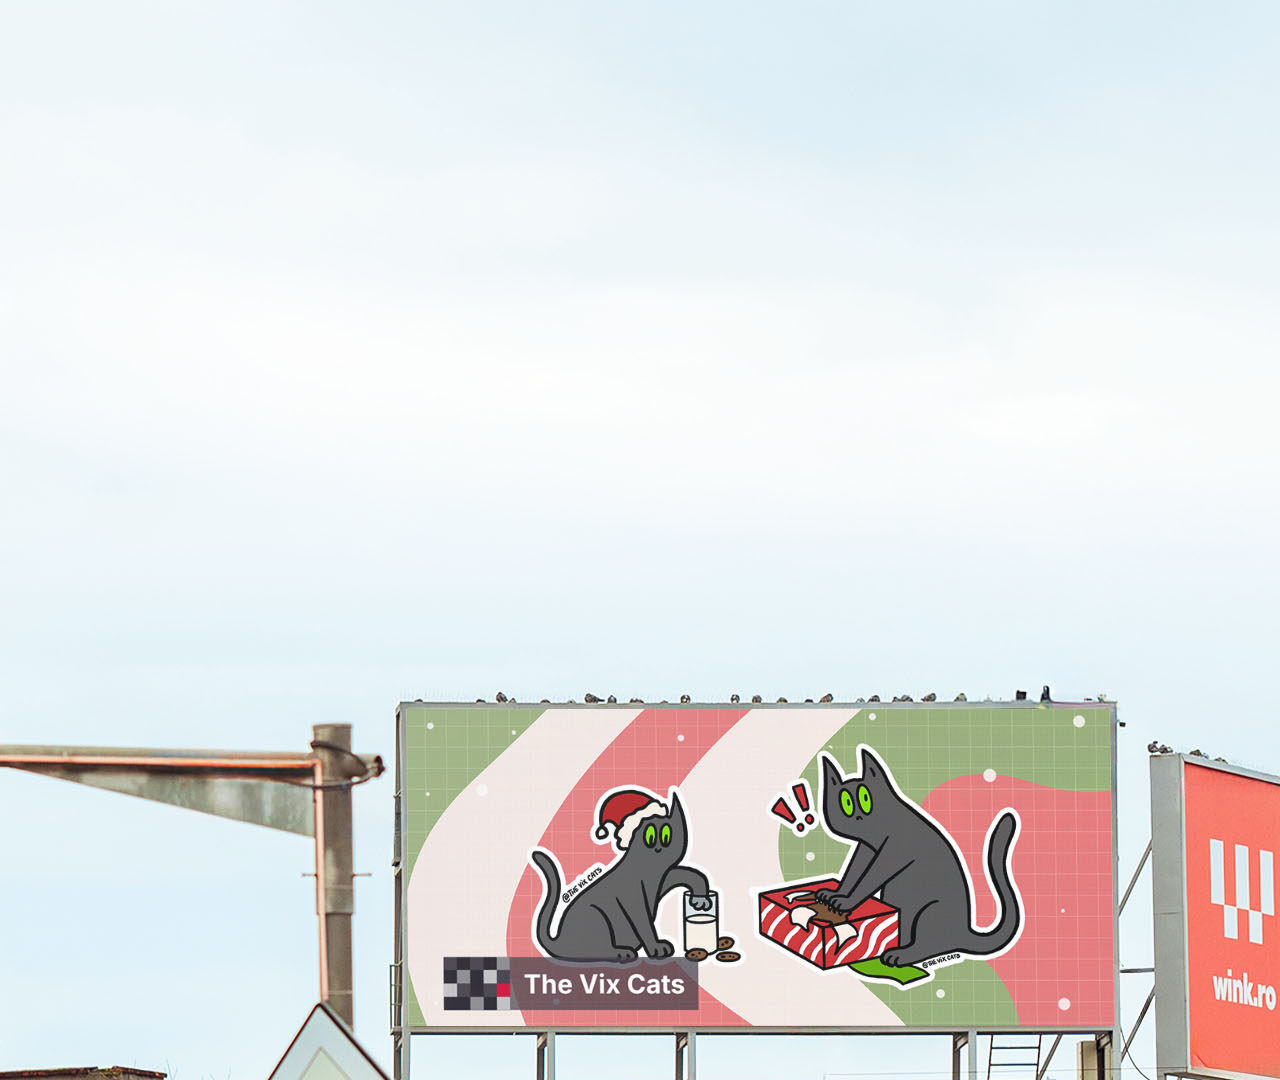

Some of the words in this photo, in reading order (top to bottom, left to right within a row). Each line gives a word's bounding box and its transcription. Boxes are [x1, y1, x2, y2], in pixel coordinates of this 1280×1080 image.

[524, 973, 573, 995] The
[579, 972, 621, 995] Vix
[627, 973, 685, 995] Cats
[1213, 968, 1276, 1010] wink.ro
